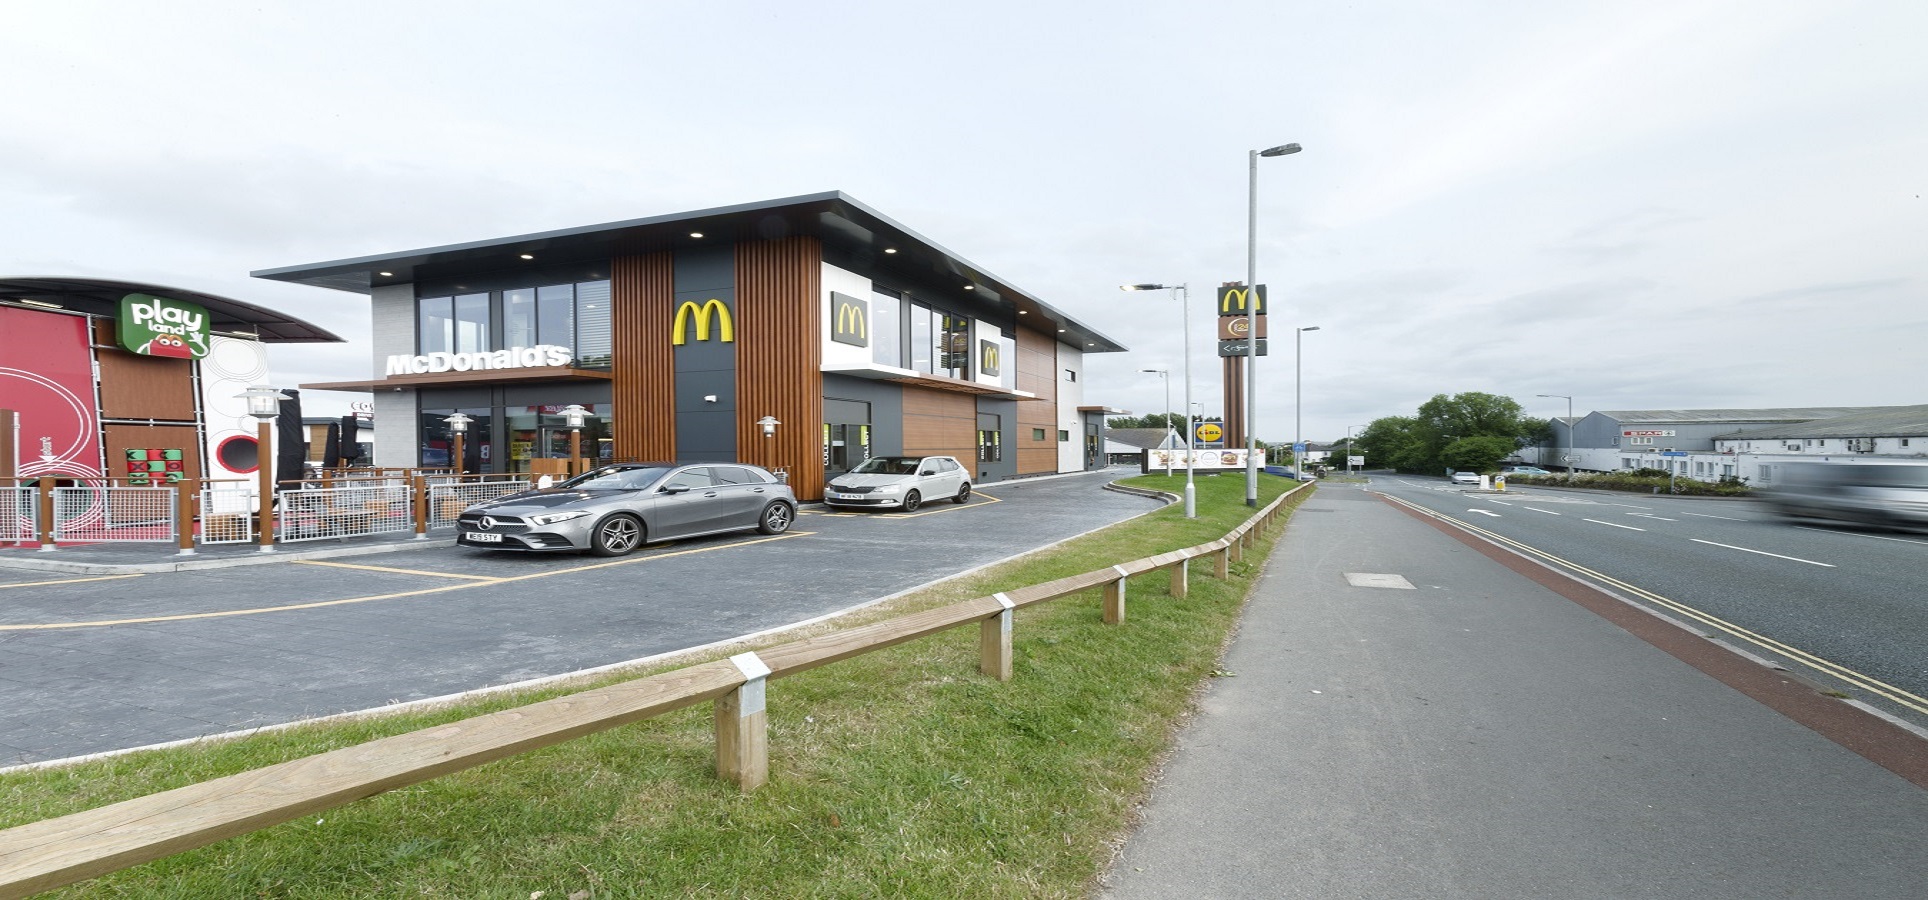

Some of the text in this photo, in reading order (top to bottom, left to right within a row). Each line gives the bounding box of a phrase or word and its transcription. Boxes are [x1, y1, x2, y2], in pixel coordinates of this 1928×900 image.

[131, 299, 203, 332] play
[148, 320, 185, 335] land
[386, 344, 571, 376] McDonald's
